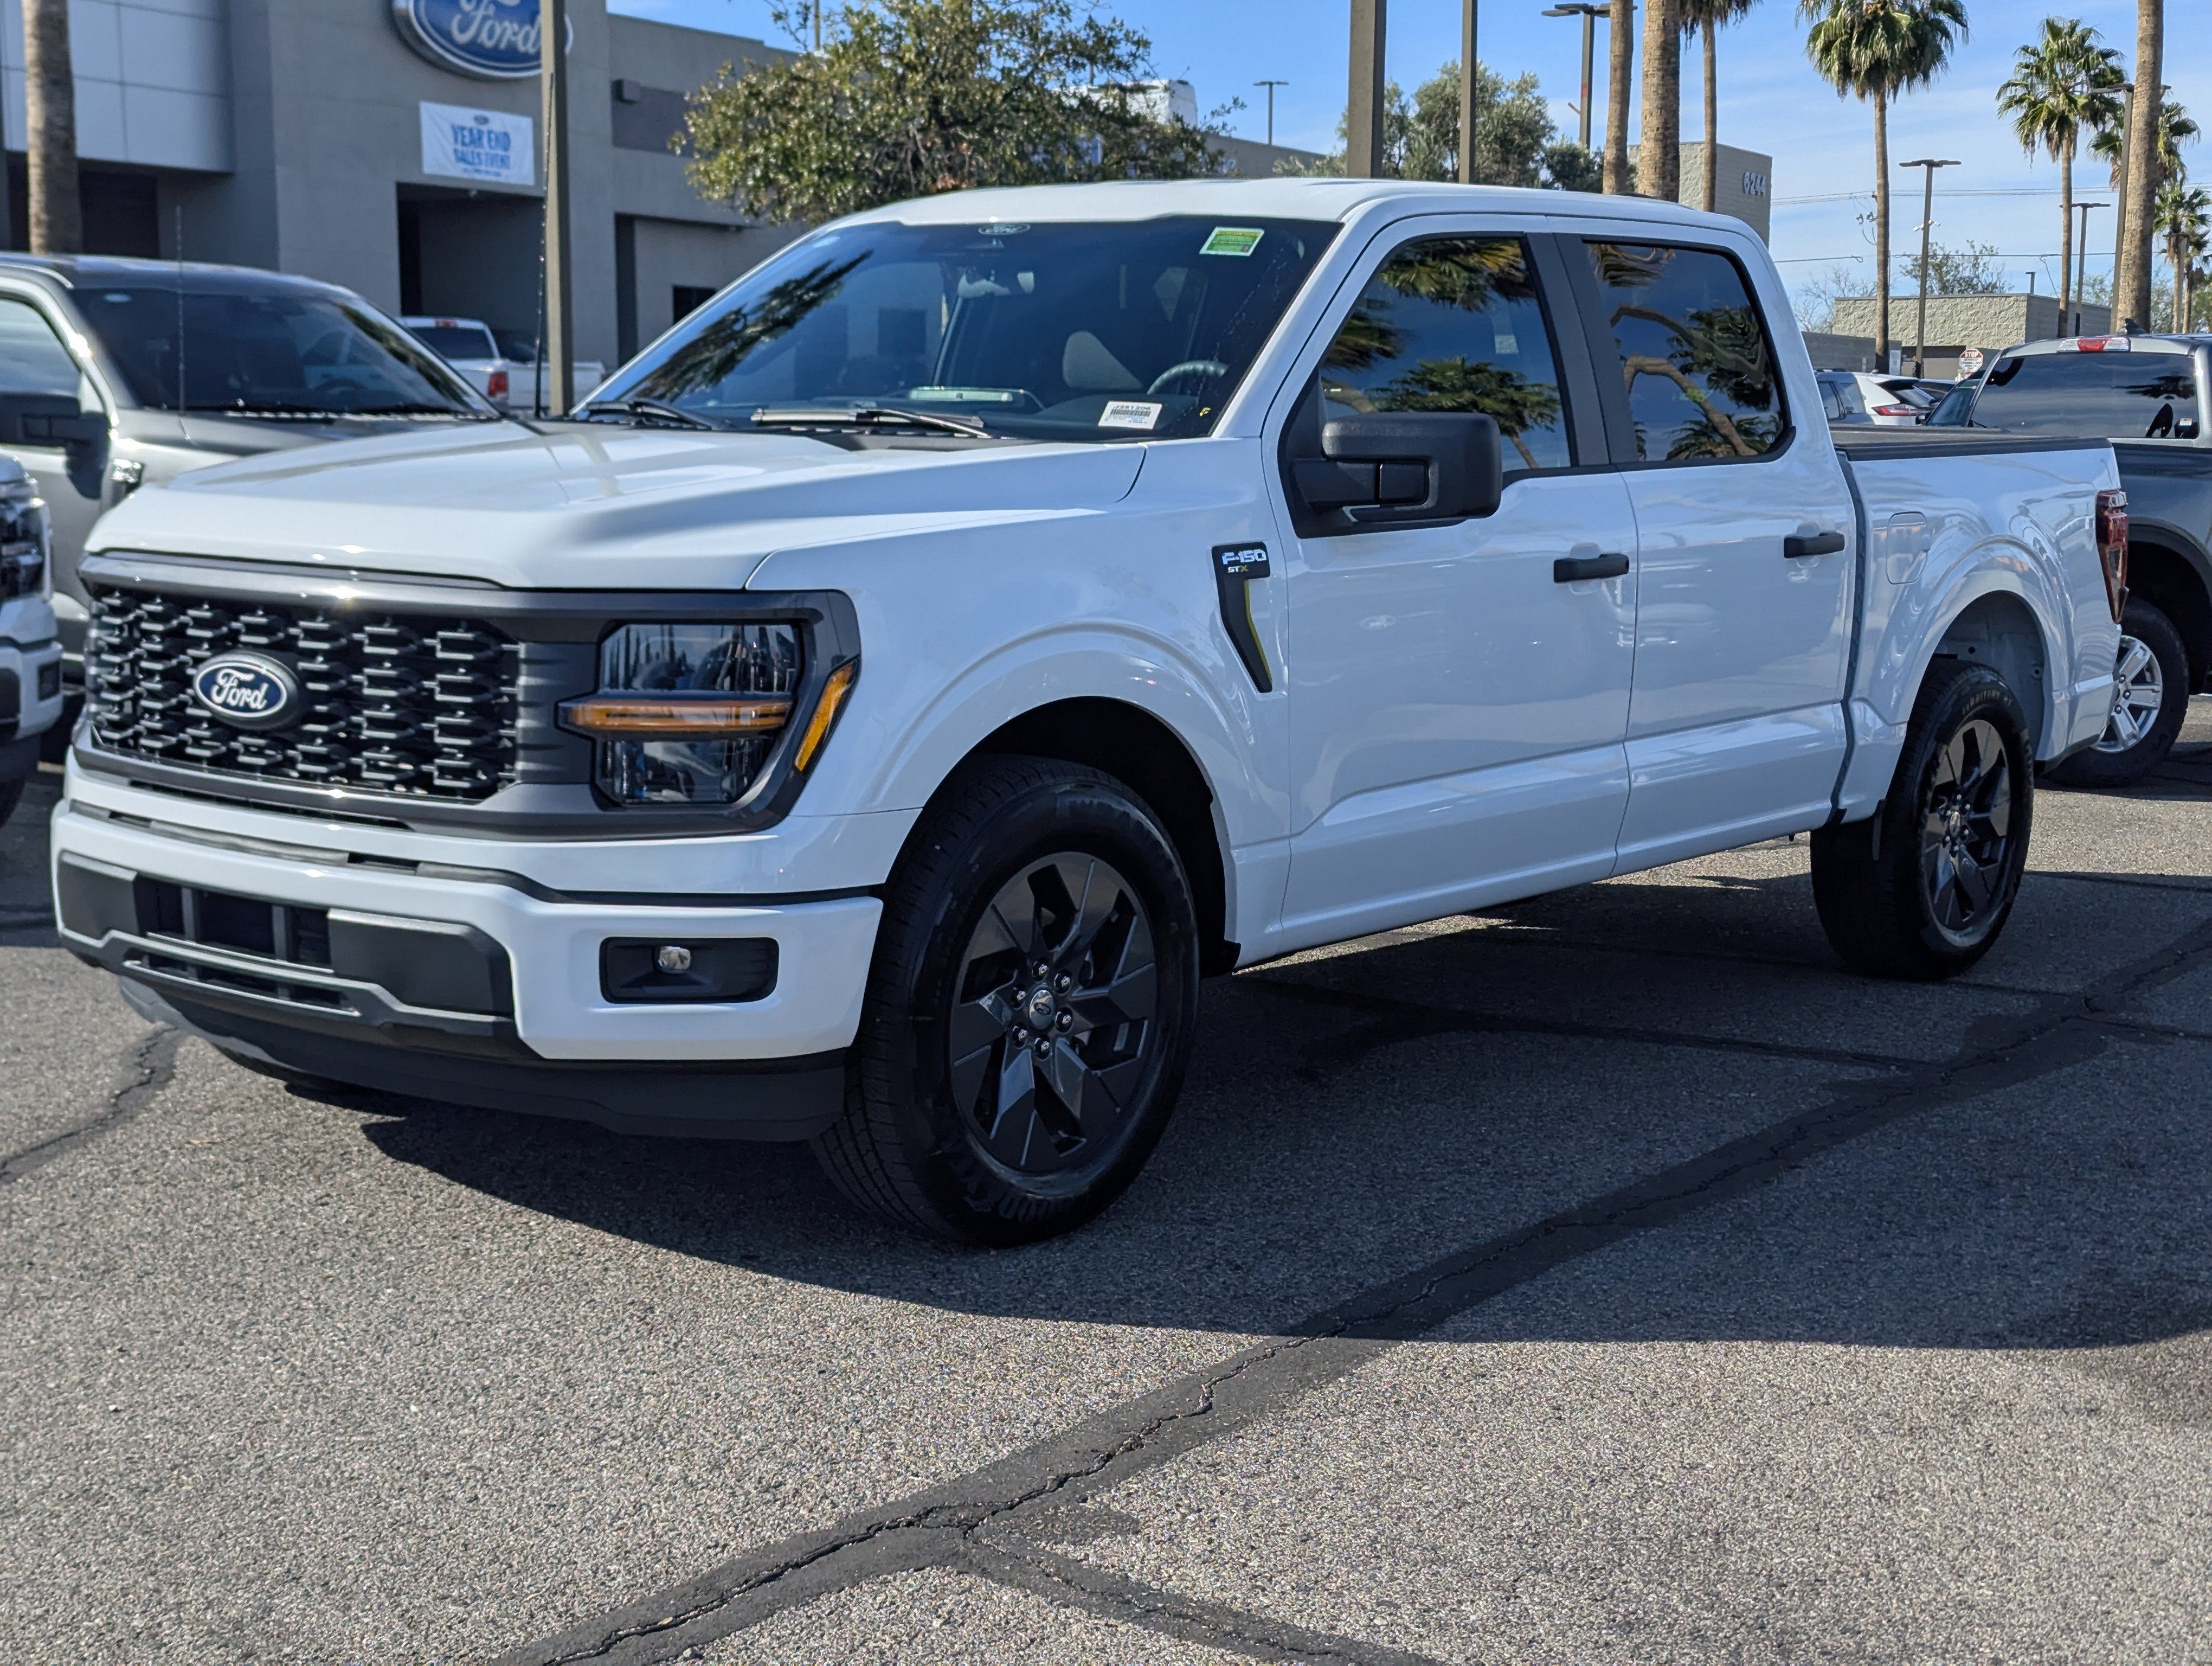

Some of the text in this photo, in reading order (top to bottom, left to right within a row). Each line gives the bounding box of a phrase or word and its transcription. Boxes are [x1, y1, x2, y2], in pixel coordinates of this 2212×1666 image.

[452, 124, 511, 152] YEAR END
[453, 148, 483, 166] SALES
[1221, 549, 1267, 565] F-150
[1227, 565, 1249, 573] STX
[211, 668, 269, 710] Ford
